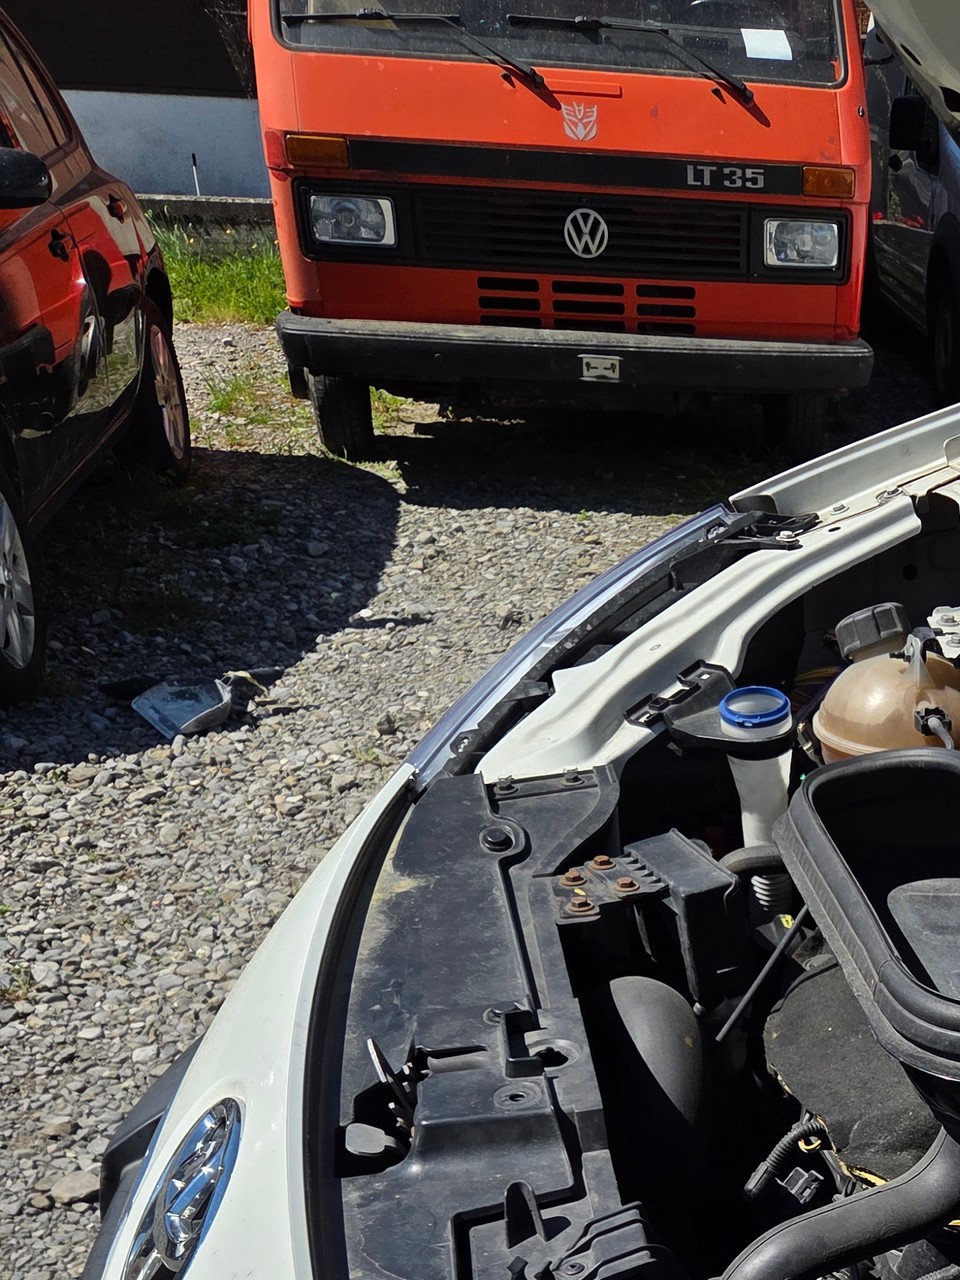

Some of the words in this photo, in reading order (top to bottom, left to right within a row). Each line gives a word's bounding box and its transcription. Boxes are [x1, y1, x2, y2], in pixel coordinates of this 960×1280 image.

[686, 164, 717, 186] LT
[723, 167, 765, 189] 35
[564, 208, 609, 259] VW
